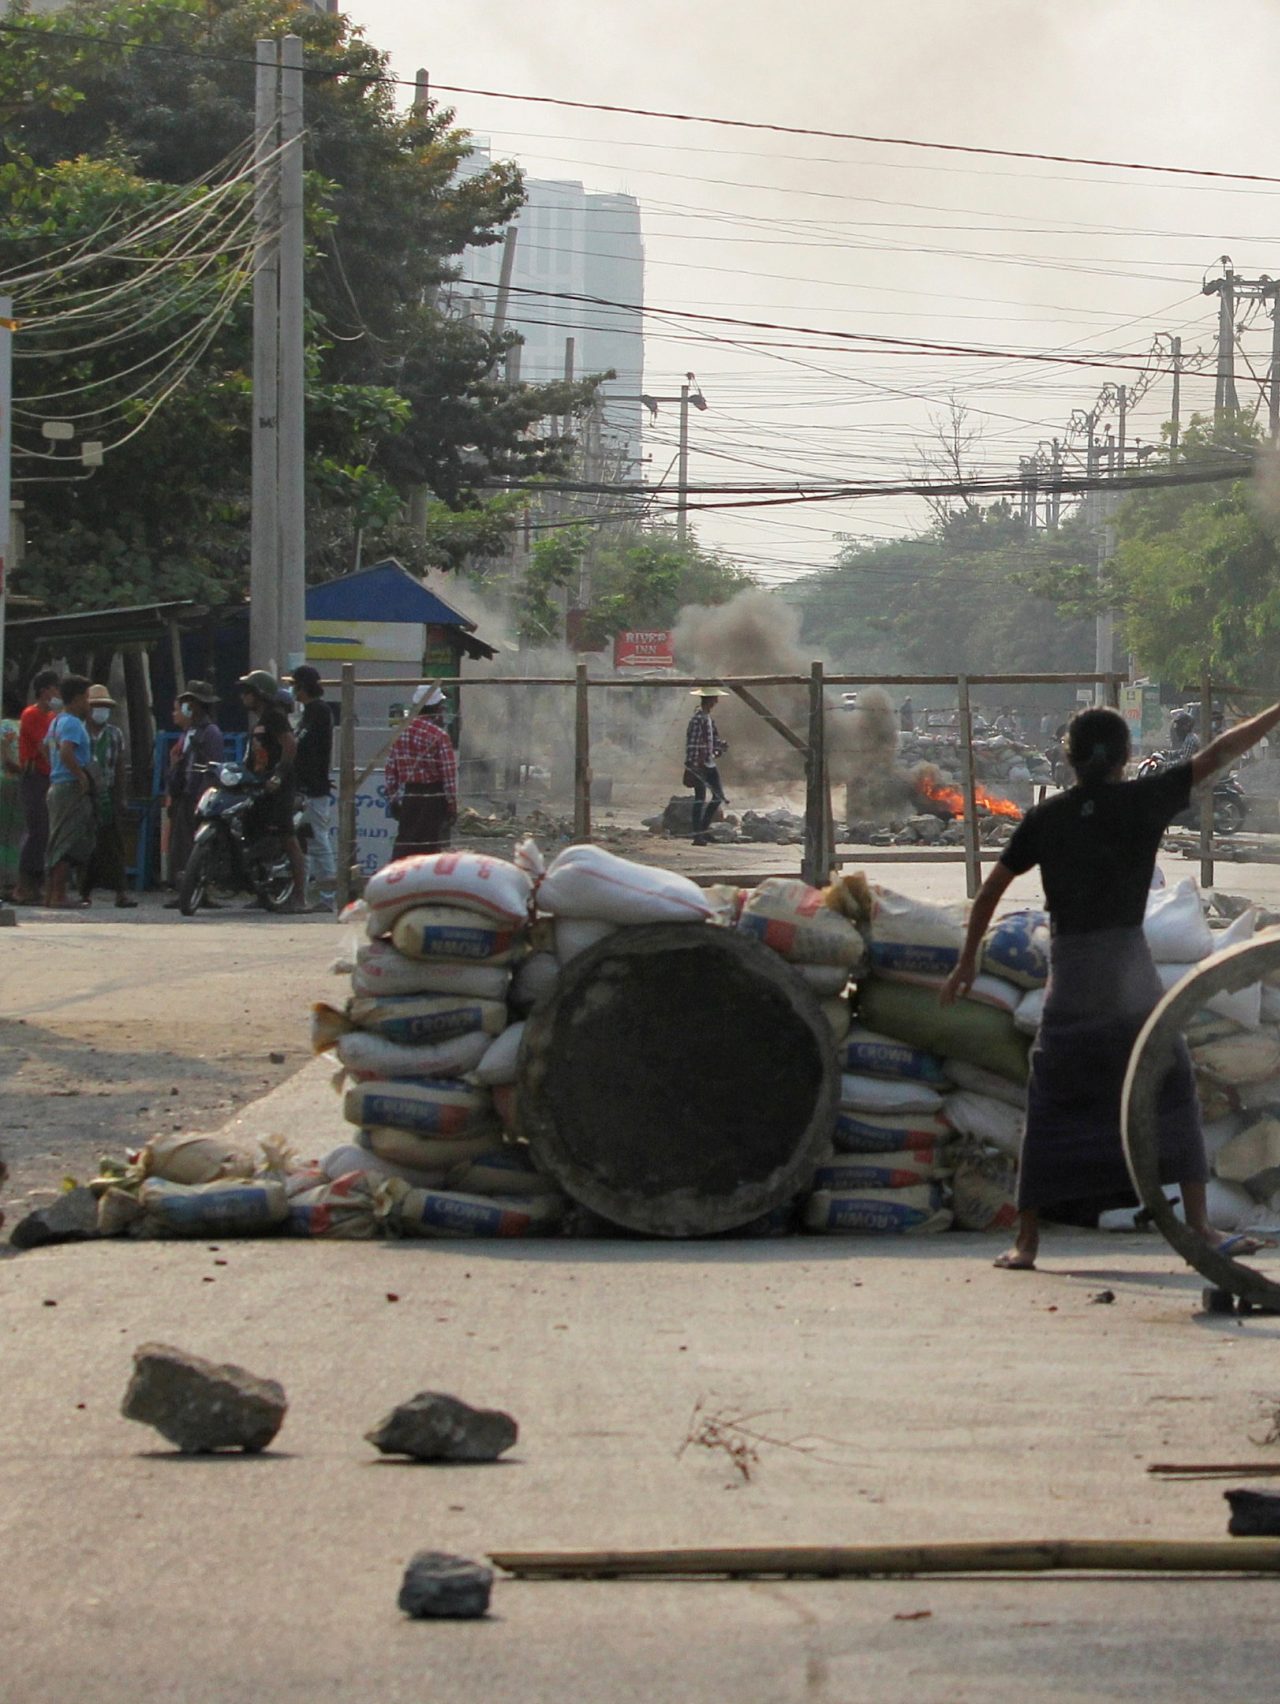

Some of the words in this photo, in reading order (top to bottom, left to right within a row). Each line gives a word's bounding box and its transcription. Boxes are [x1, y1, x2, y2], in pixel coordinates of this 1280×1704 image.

[626, 632, 666, 643] RIVER
[635, 645, 657, 654] INN
[411, 1012, 474, 1035] CROWN
[857, 1045, 913, 1064] CROWN
[435, 1199, 491, 1220] CROWN
[836, 1212, 899, 1230] CROWN
